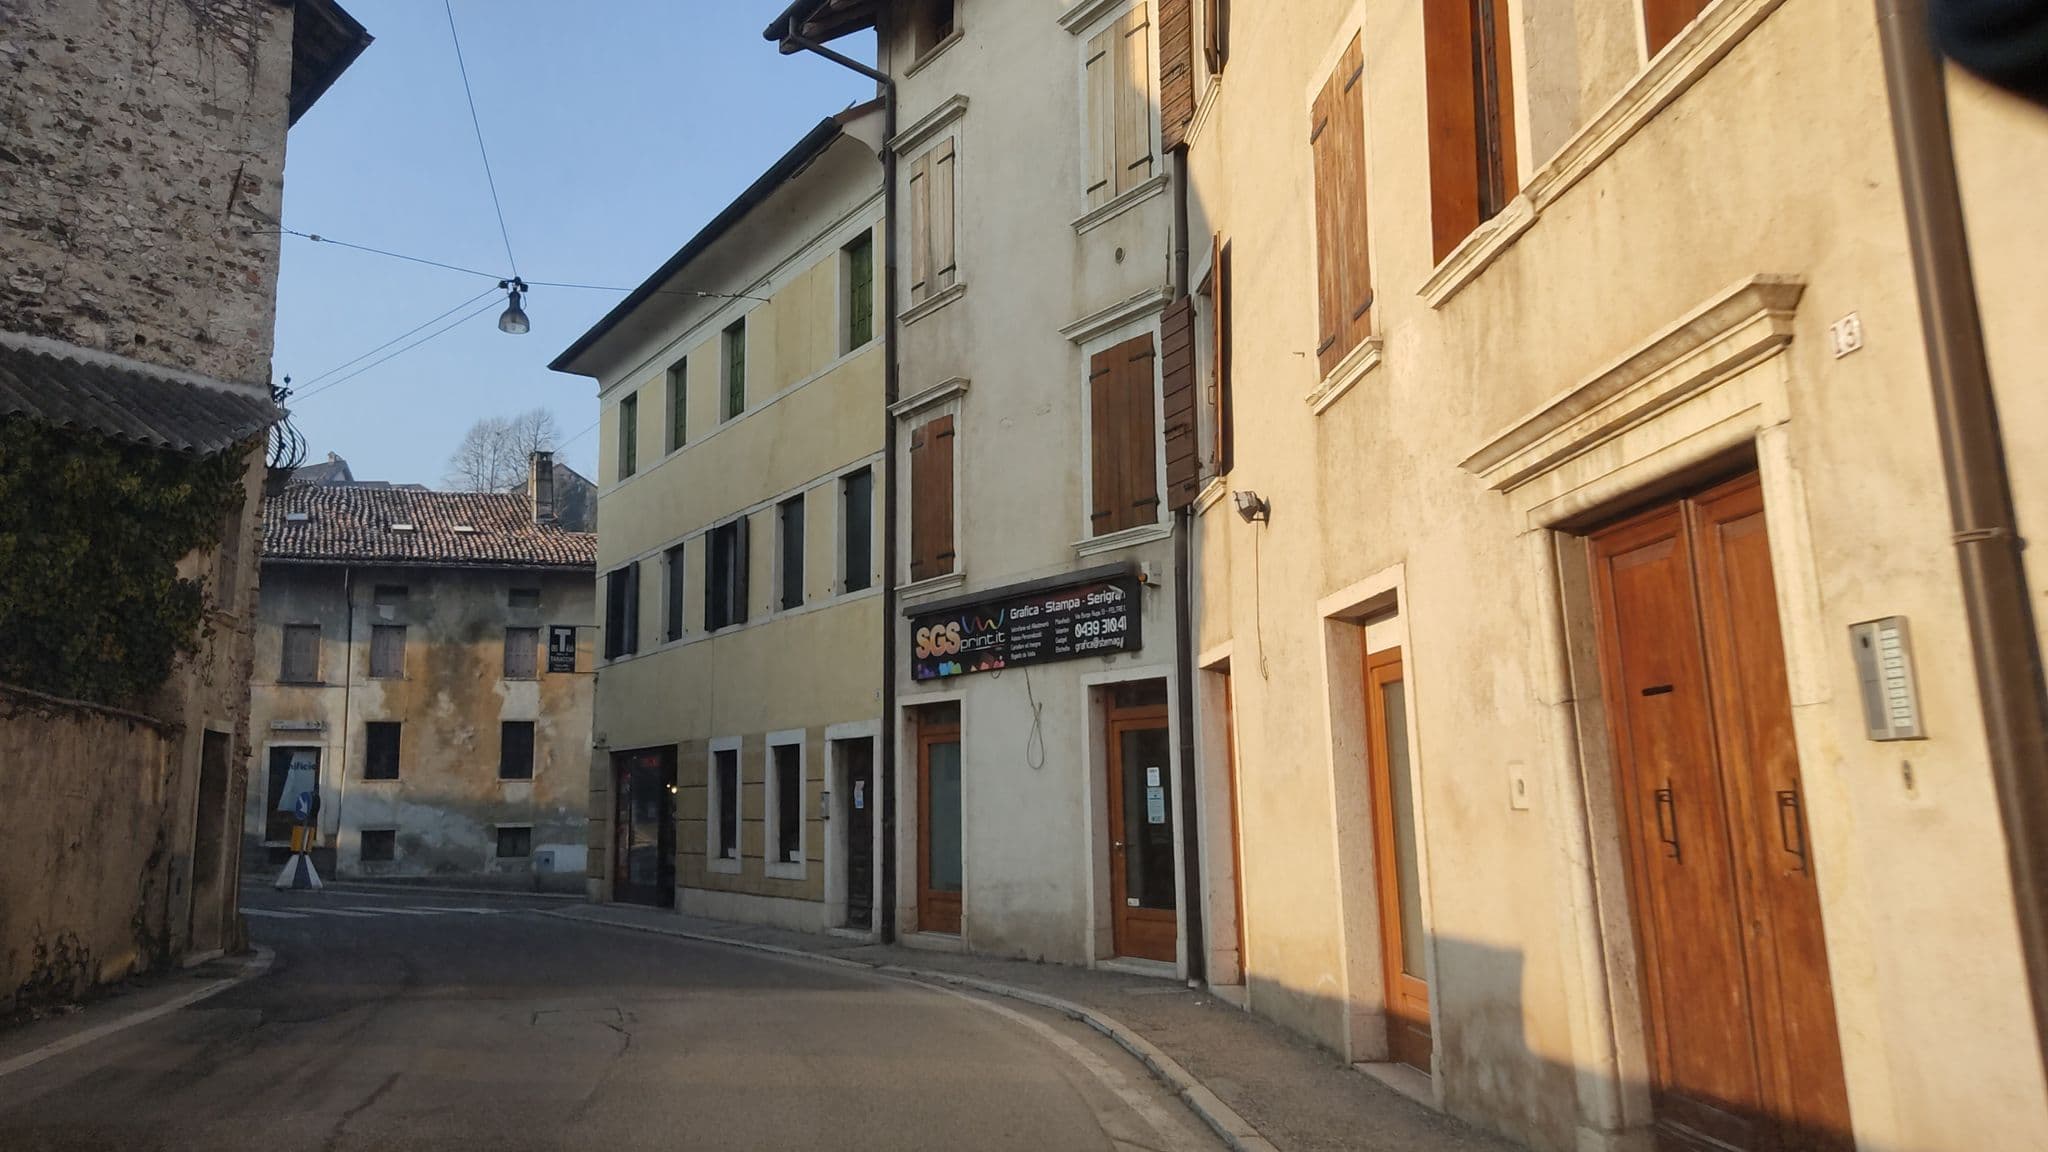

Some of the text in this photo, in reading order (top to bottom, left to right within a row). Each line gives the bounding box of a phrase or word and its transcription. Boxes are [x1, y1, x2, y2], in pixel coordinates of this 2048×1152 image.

[1010, 605, 1039, 620] Grafica
[1045, 598, 1080, 614] Stampa
[554, 628, 572, 652] T
[916, 621, 960, 659] SGS
[1075, 620, 1100, 638] 0439
[960, 630, 1006, 652] print.it
